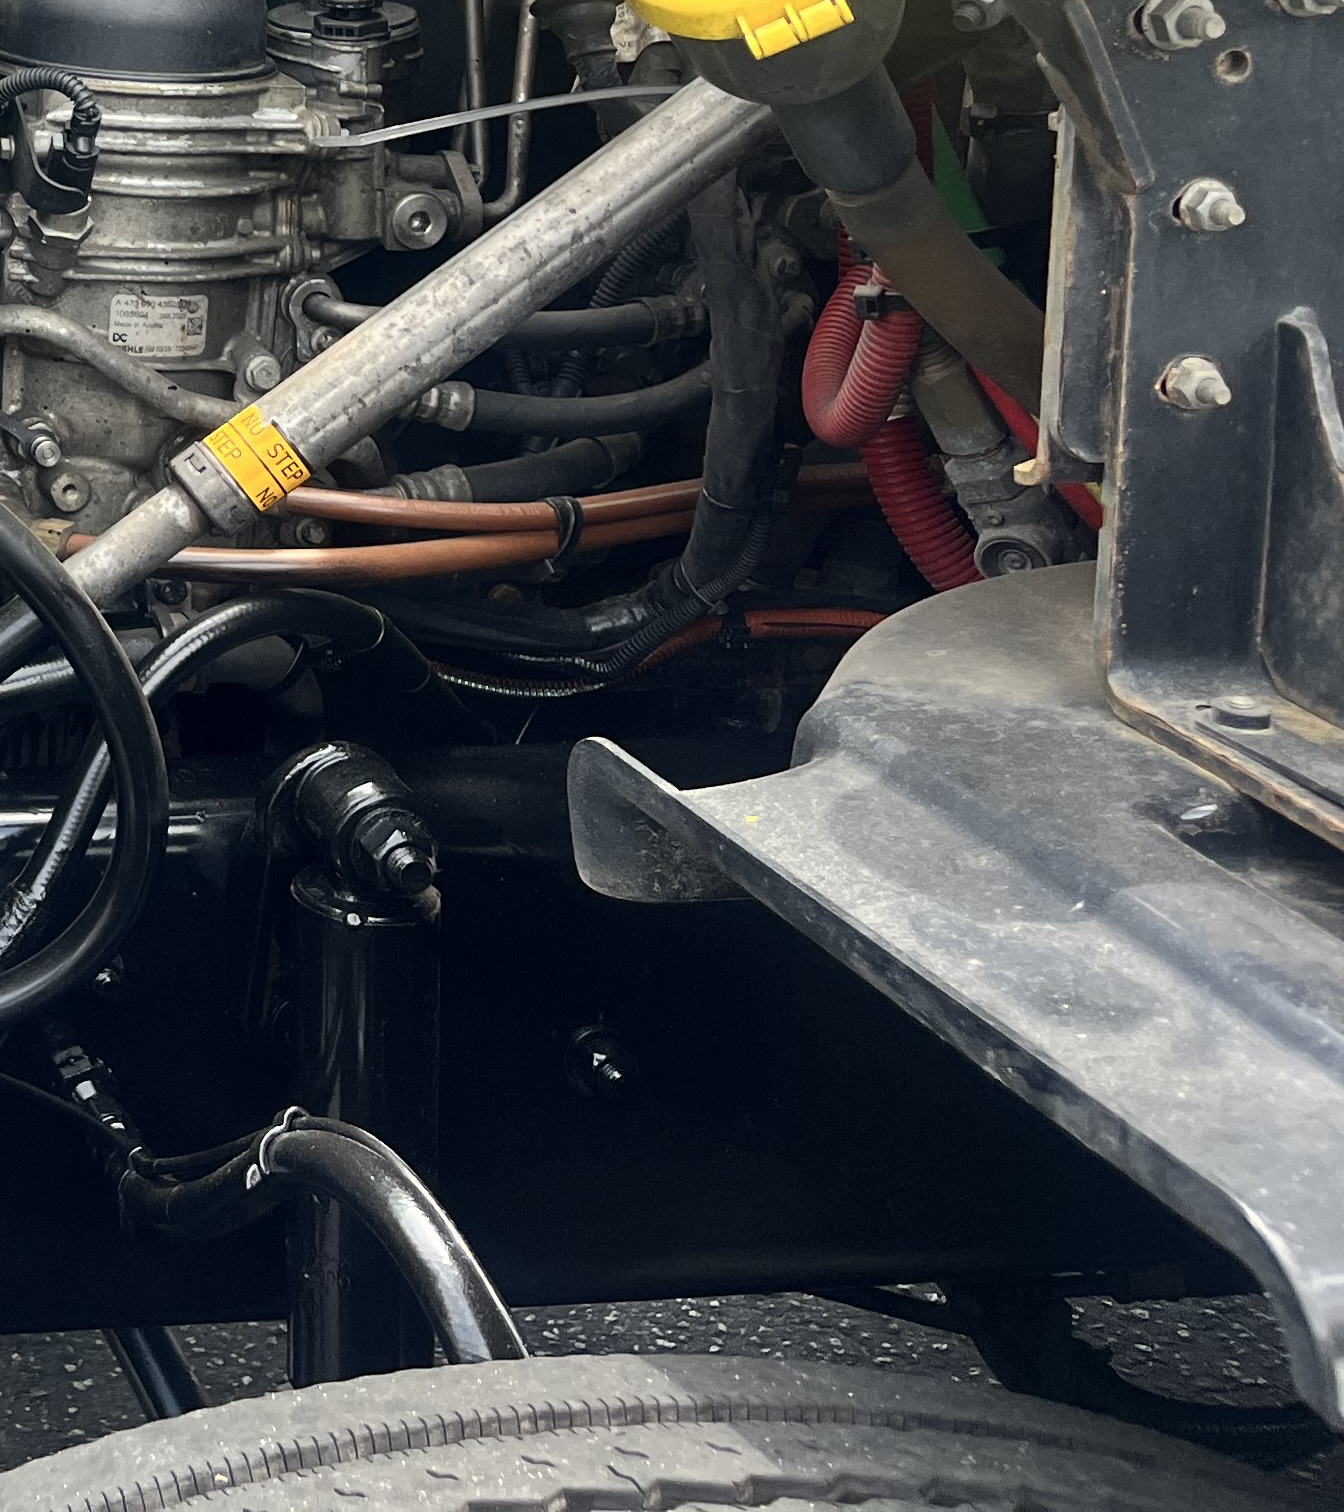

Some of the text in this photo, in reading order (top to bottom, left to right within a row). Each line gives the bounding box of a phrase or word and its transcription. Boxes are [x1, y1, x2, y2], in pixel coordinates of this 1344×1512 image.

[112, 332, 128, 343] DC
[208, 429, 242, 460] STEP
[267, 443, 304, 480] STEP
